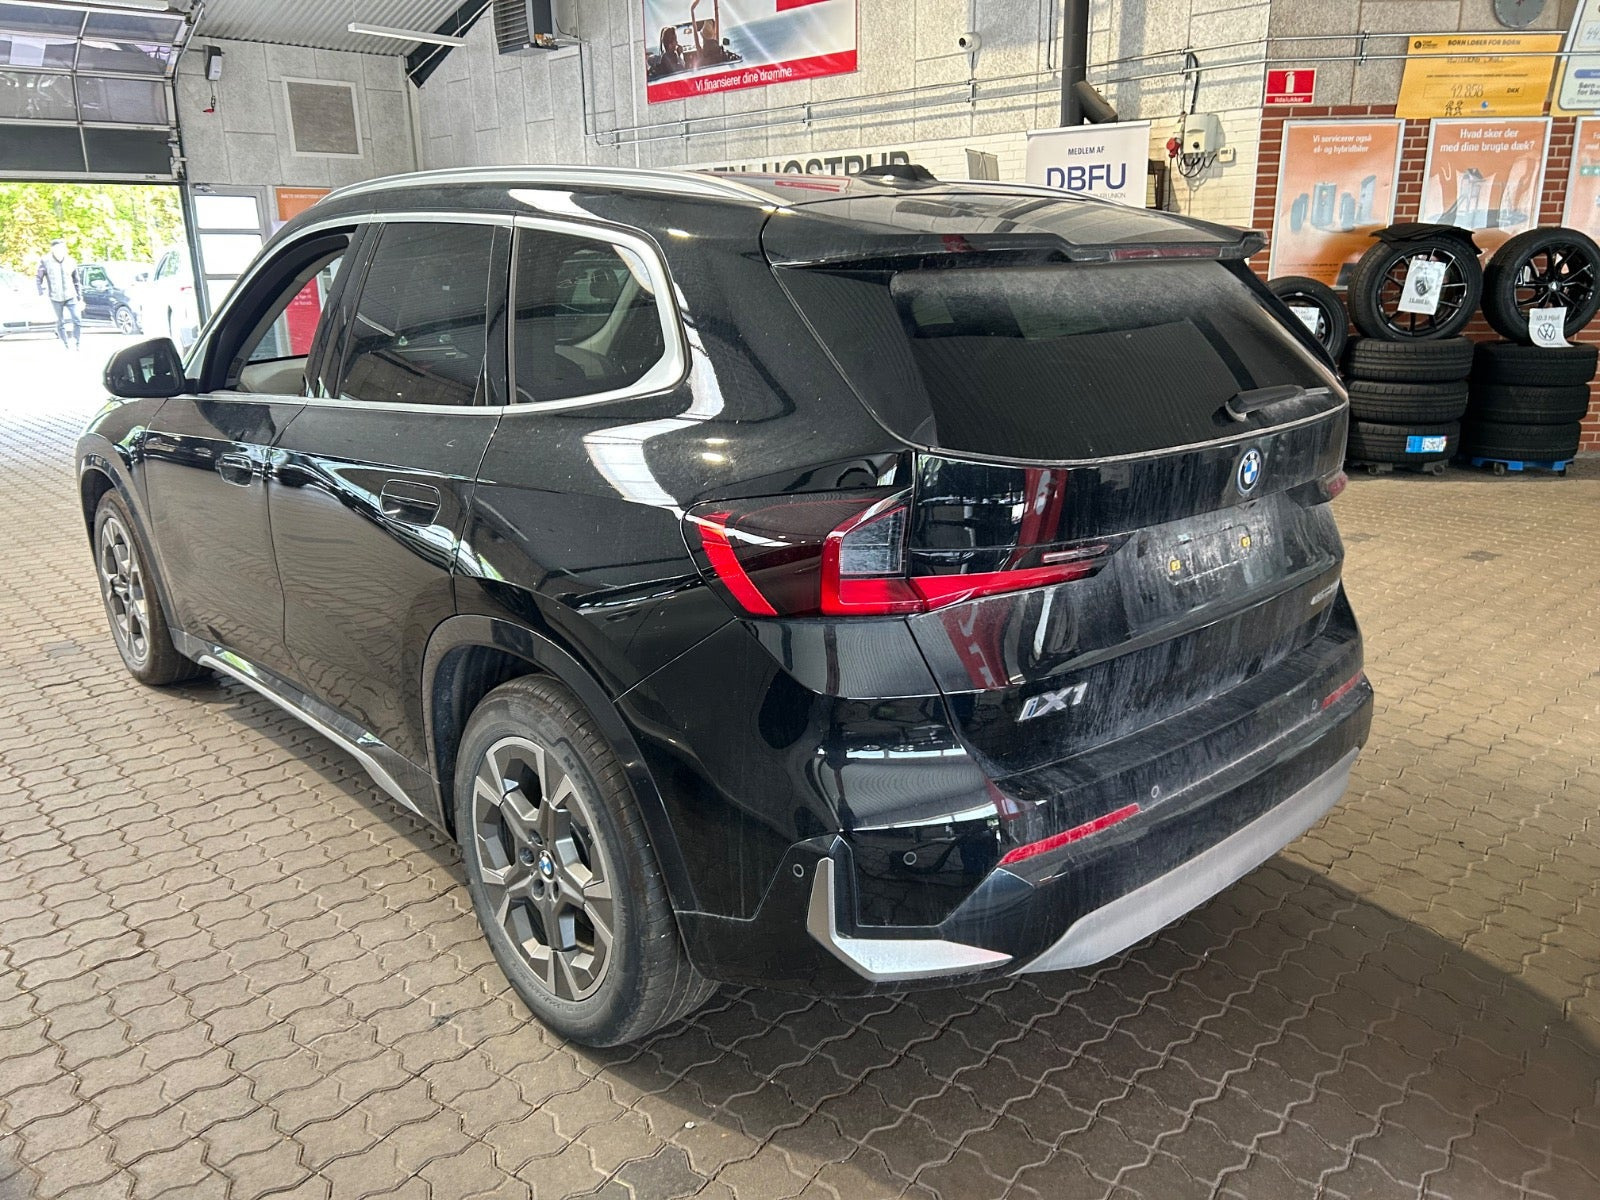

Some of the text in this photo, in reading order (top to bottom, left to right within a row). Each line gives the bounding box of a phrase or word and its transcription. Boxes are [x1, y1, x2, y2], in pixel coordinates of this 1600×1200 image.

[695, 67, 792, 91] Vi finansierer dine drømme
[1321, 134, 1355, 142] servicerer
[1355, 134, 1372, 143] også
[1460, 128, 1519, 139] Hvad sker der
[1068, 147, 1096, 155] MEDLEM
[1324, 147, 1333, 155] og
[1334, 145, 1369, 154] hybridbiler
[1440, 140, 1535, 153] med dine brugte dæk?
[1046, 163, 1126, 191] DBFU
[1018, 682, 1088, 721] iX1
